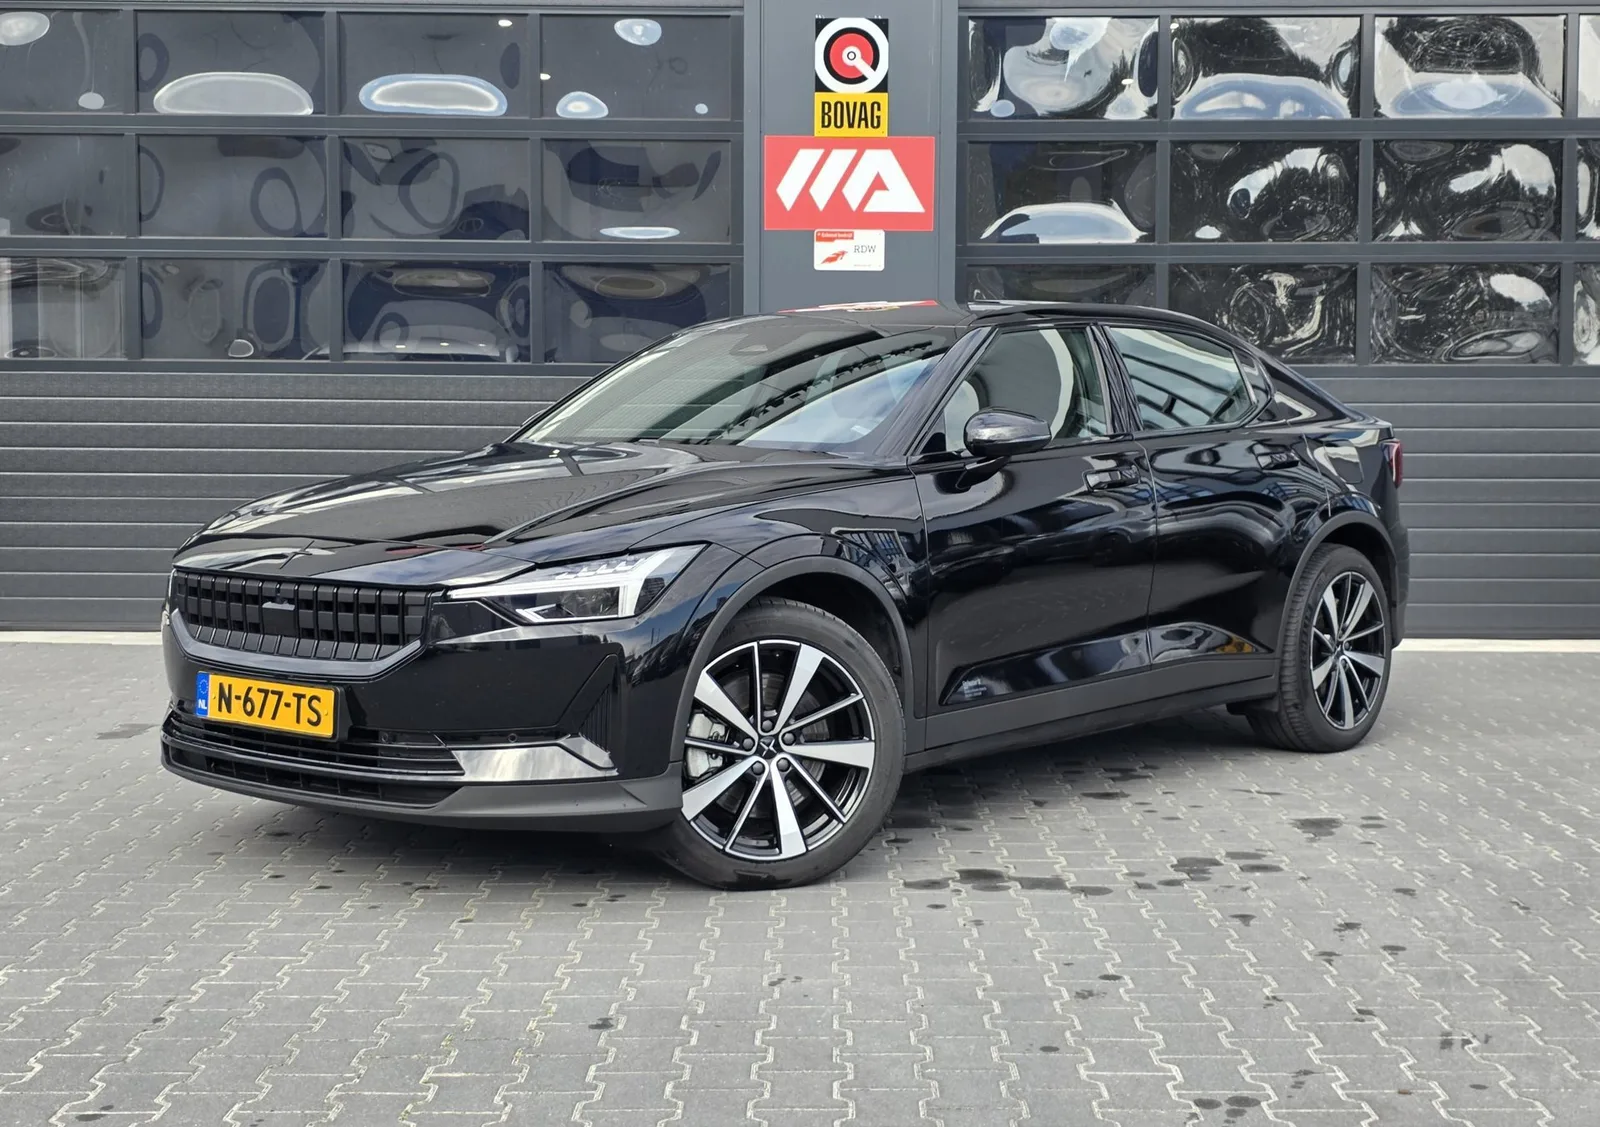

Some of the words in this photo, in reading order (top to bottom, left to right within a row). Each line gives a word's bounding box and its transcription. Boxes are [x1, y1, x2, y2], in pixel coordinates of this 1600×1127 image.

[821, 101, 882, 129] BOVAG
[853, 244, 877, 254] RDW
[198, 698, 208, 710] NL
[217, 682, 322, 727] N-677-TS
